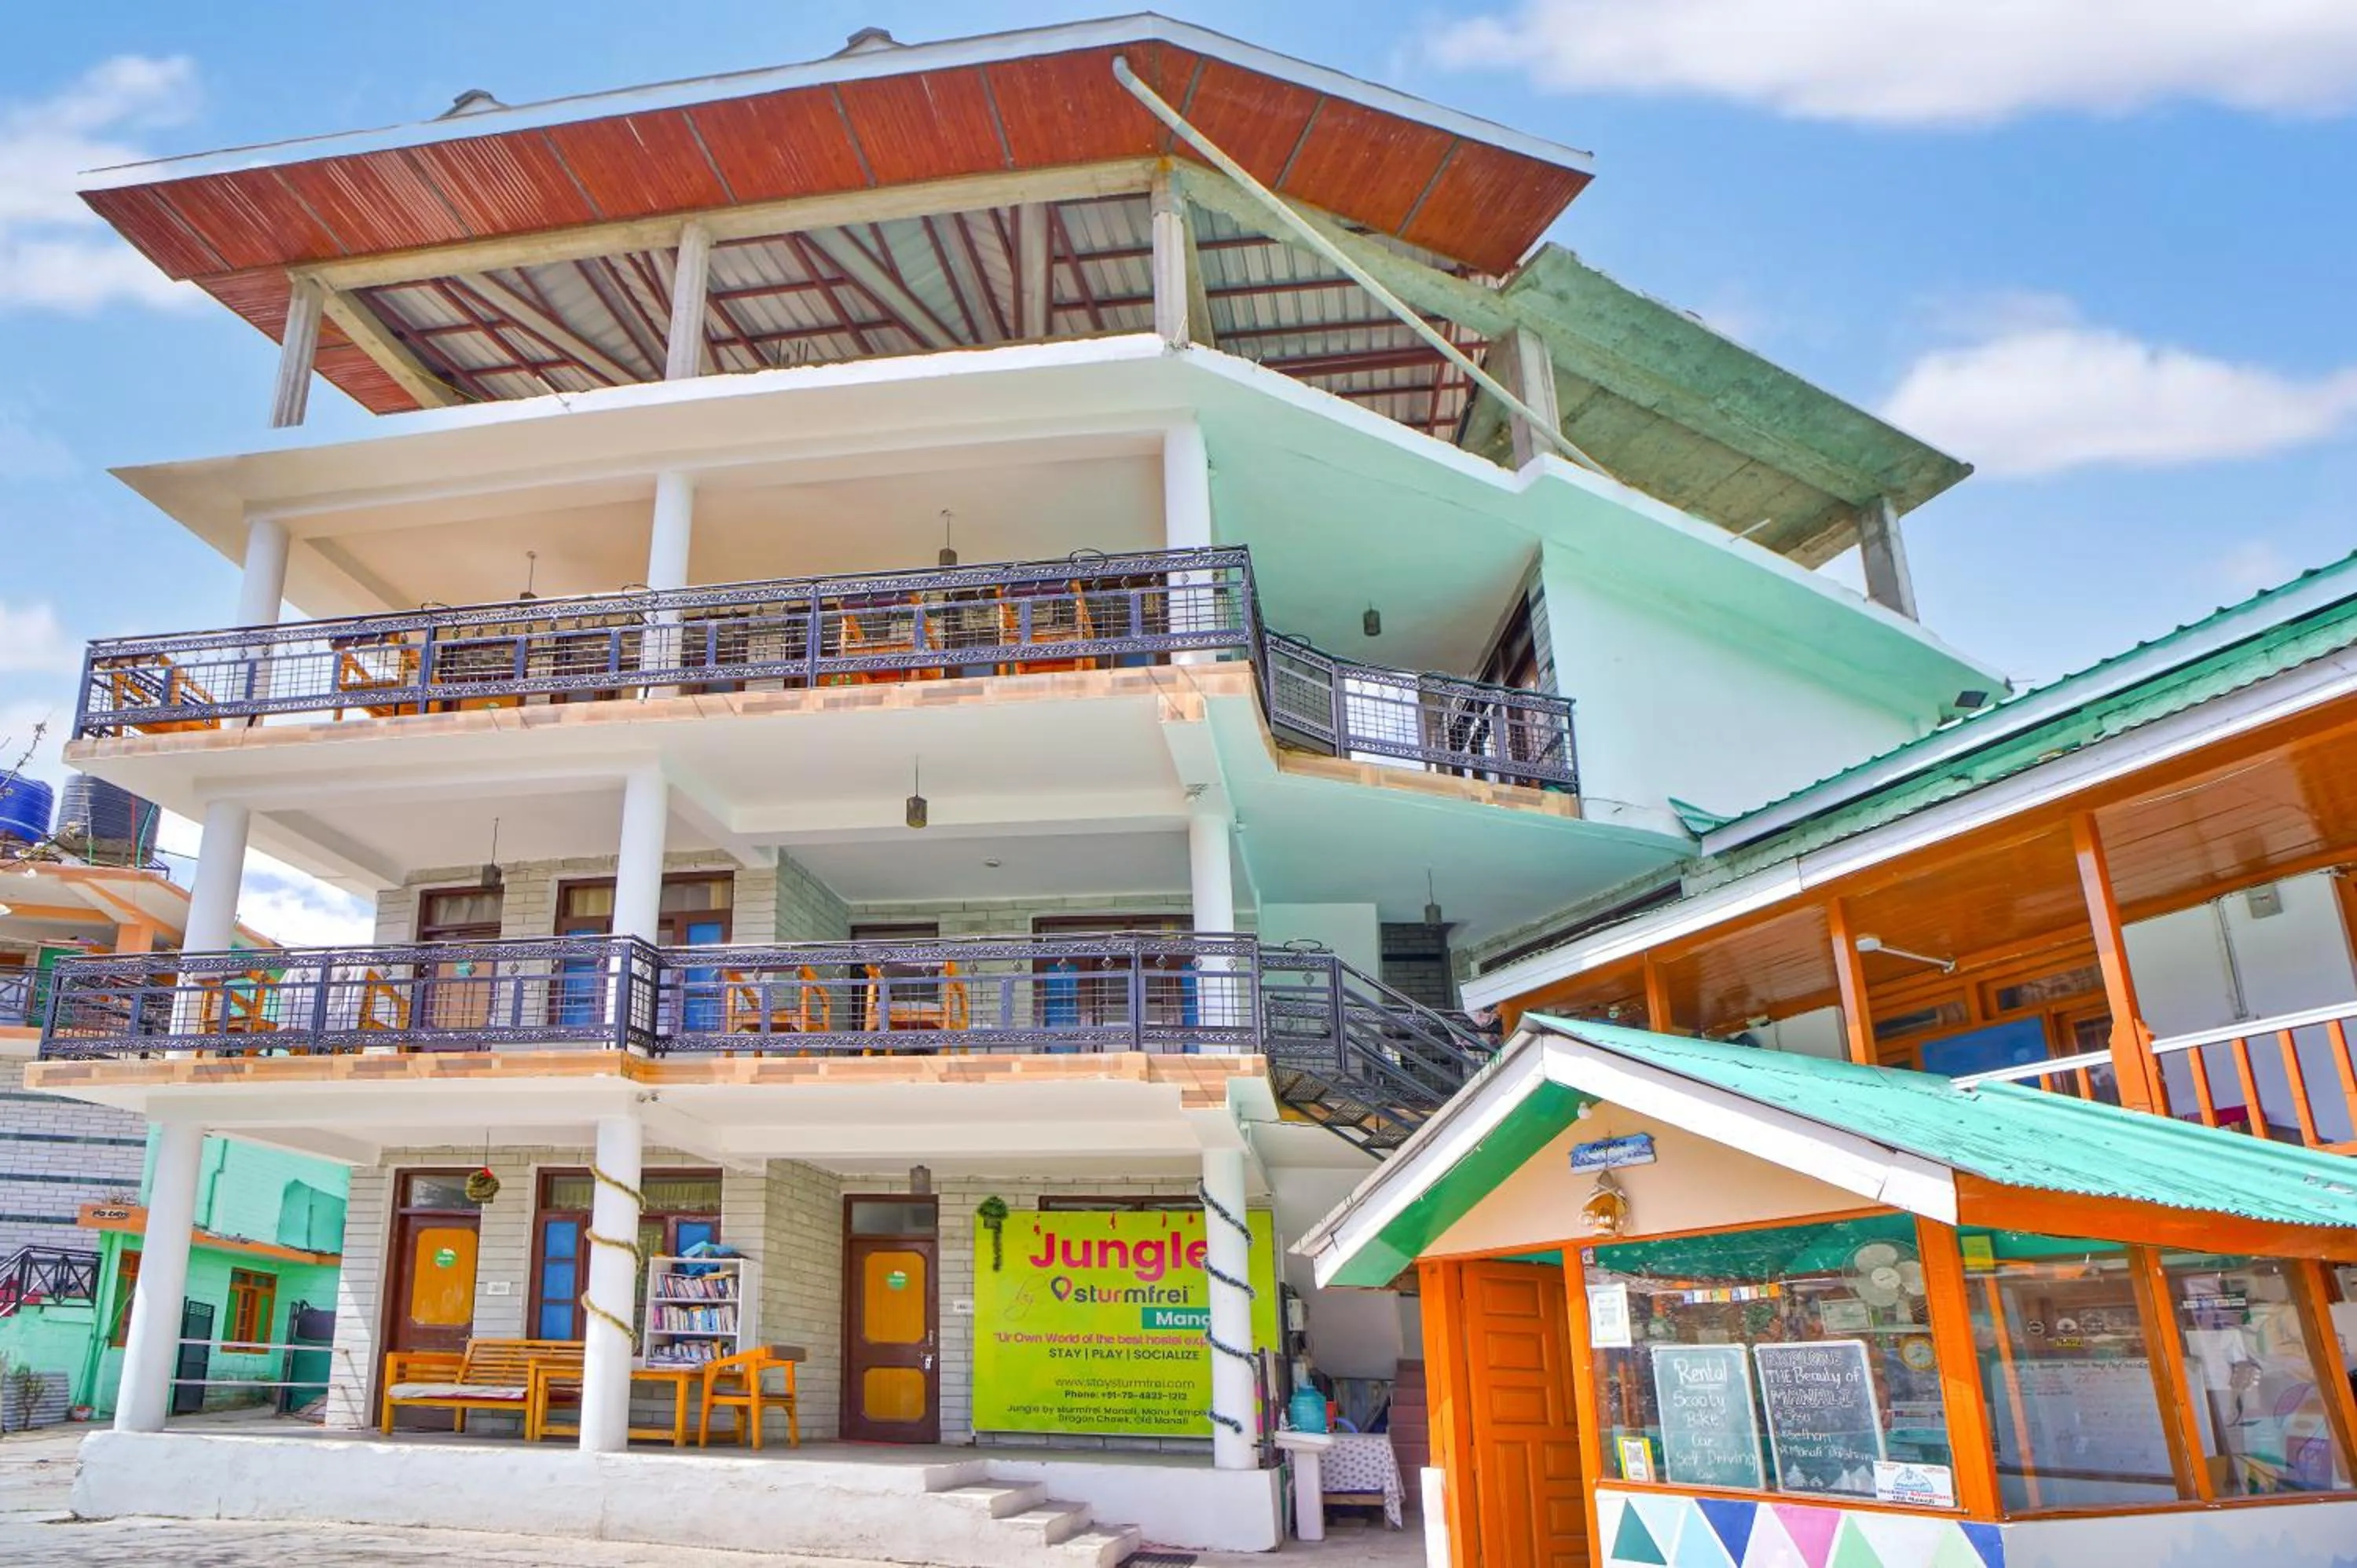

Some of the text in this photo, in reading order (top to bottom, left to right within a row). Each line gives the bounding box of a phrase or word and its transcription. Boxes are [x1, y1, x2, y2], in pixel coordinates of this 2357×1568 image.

[1030, 1231, 1208, 1280] Jungle
[1074, 1284, 1189, 1303] sturmfrei
[1014, 1332, 1042, 1343] Own
[1046, 1332, 1080, 1343] World
[1082, 1333, 1093, 1343] of
[1096, 1333, 1114, 1343] the
[1117, 1334, 1143, 1344] best
[1146, 1335, 1182, 1345] hostel
[1049, 1348, 1081, 1358] STAY
[1091, 1349, 1122, 1359] PLAY
[1134, 1350, 1200, 1360] SOCIALIZE
[1674, 1358, 1728, 1385] Rental
[1765, 1369, 1791, 1383] THE
[1846, 1366, 1861, 1383] of
[1065, 1390, 1098, 1398] Phone:
[1006, 1405, 1039, 1414] Jungle
[1043, 1405, 1054, 1414] by
[1057, 1405, 1101, 1414] sturmfrei
[1059, 1415, 1094, 1423] Dragon
